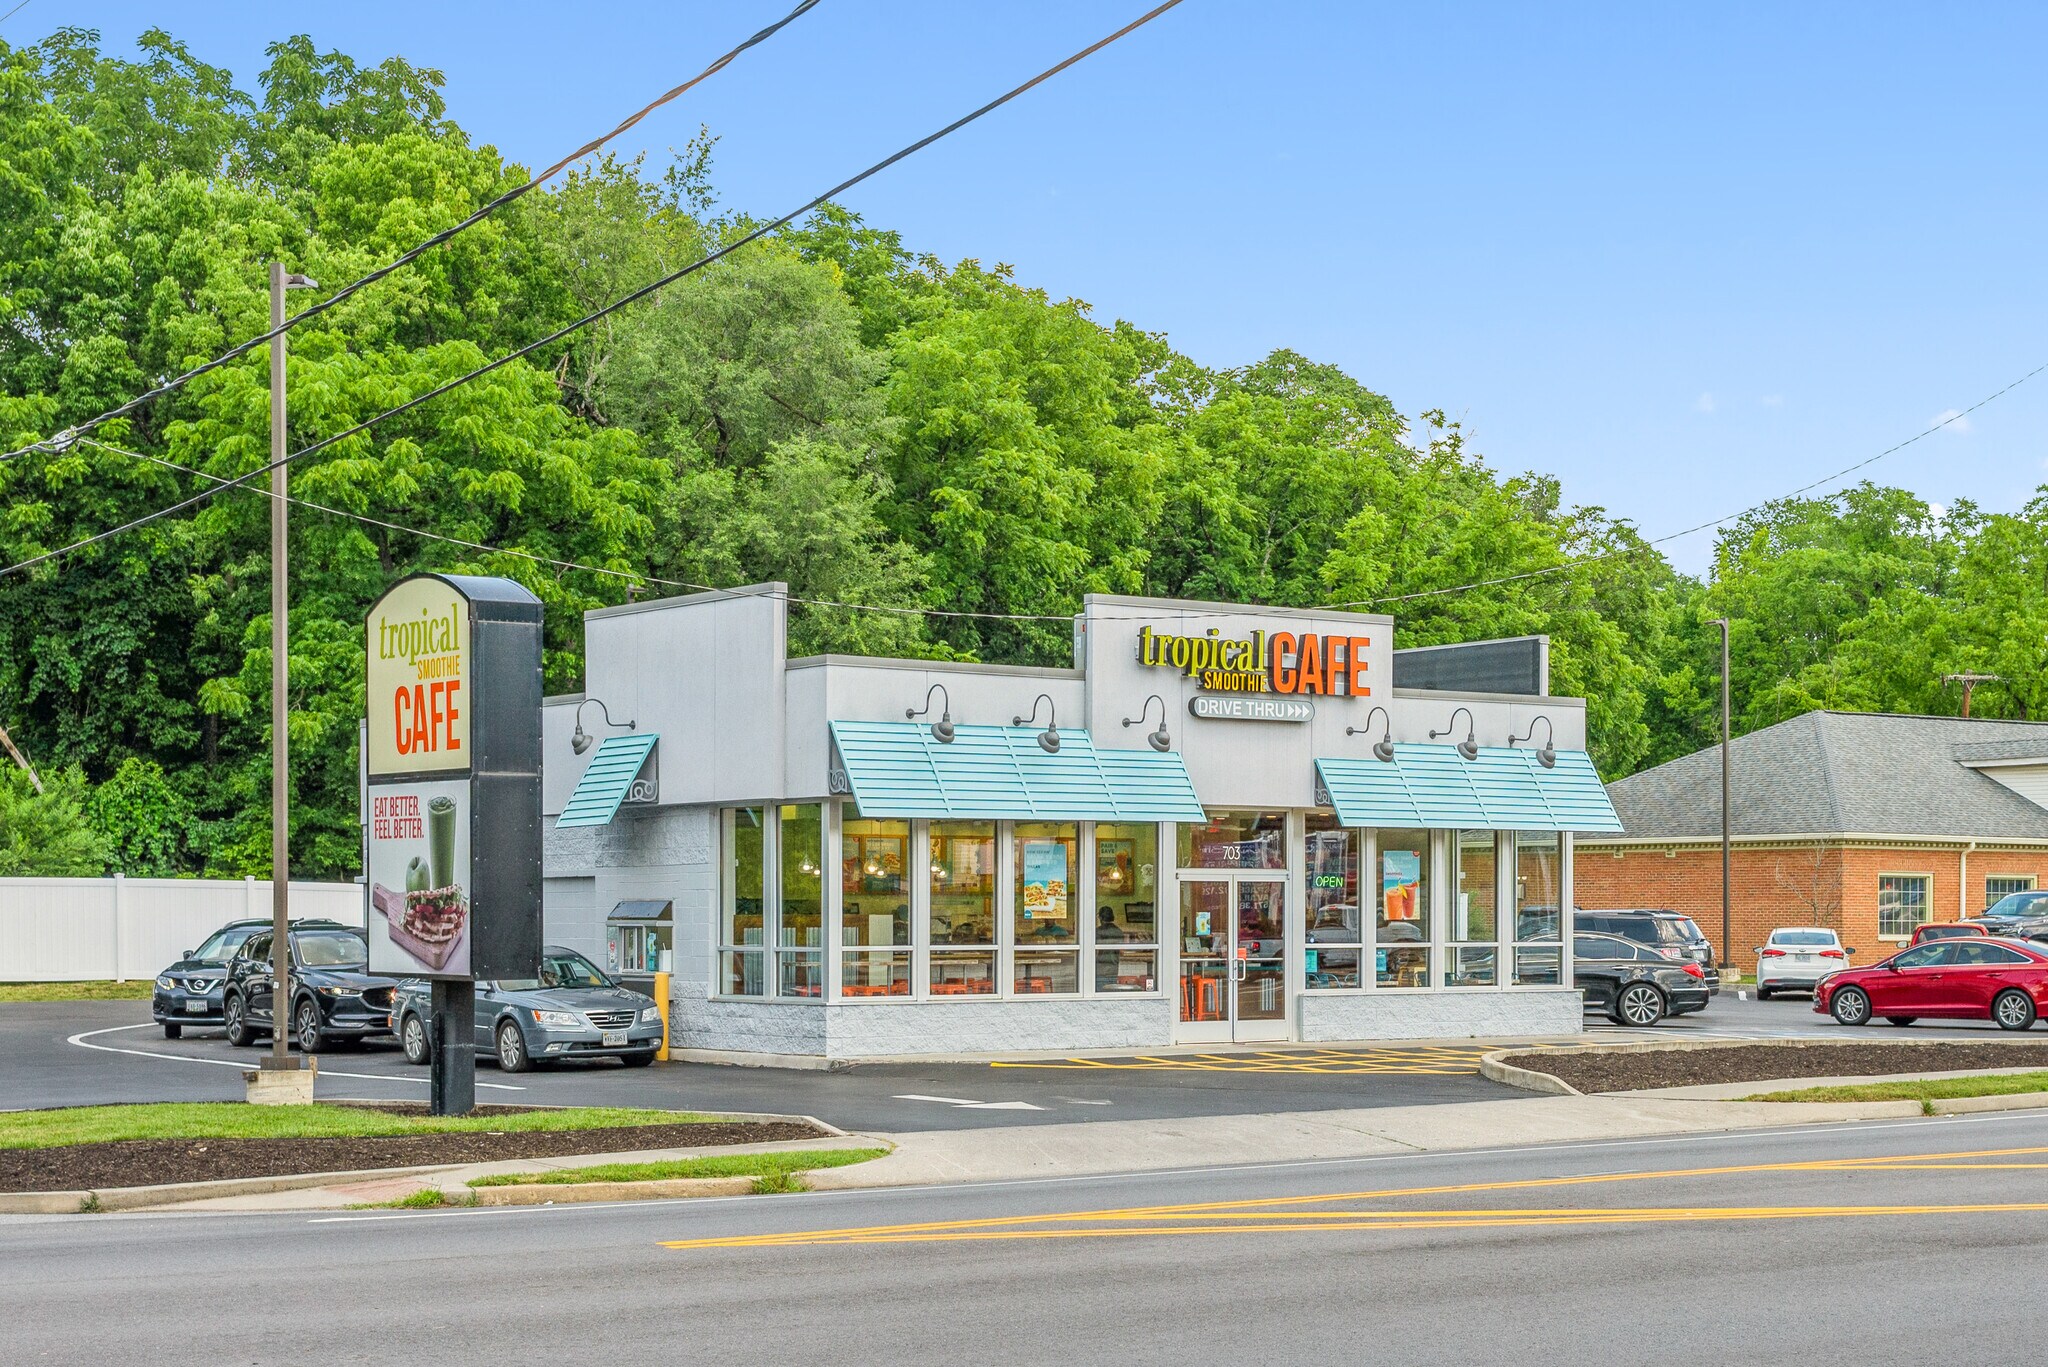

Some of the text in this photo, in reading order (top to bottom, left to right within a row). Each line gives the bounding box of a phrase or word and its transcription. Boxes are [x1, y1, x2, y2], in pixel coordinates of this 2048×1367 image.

[379, 602, 460, 666] tropical
[417, 654, 460, 680] SMOOTHIE
[1140, 625, 1371, 696] tropical CAFE
[1203, 671, 1267, 693] SMOOTHIE
[394, 679, 461, 756] CAFE
[1197, 699, 1285, 718] DRIVE THRU
[374, 795, 421, 818] EAT BETTER.
[374, 817, 425, 840] FEEL BETTER.
[1222, 845, 1241, 860] 703
[1315, 875, 1344, 888] OPEN
